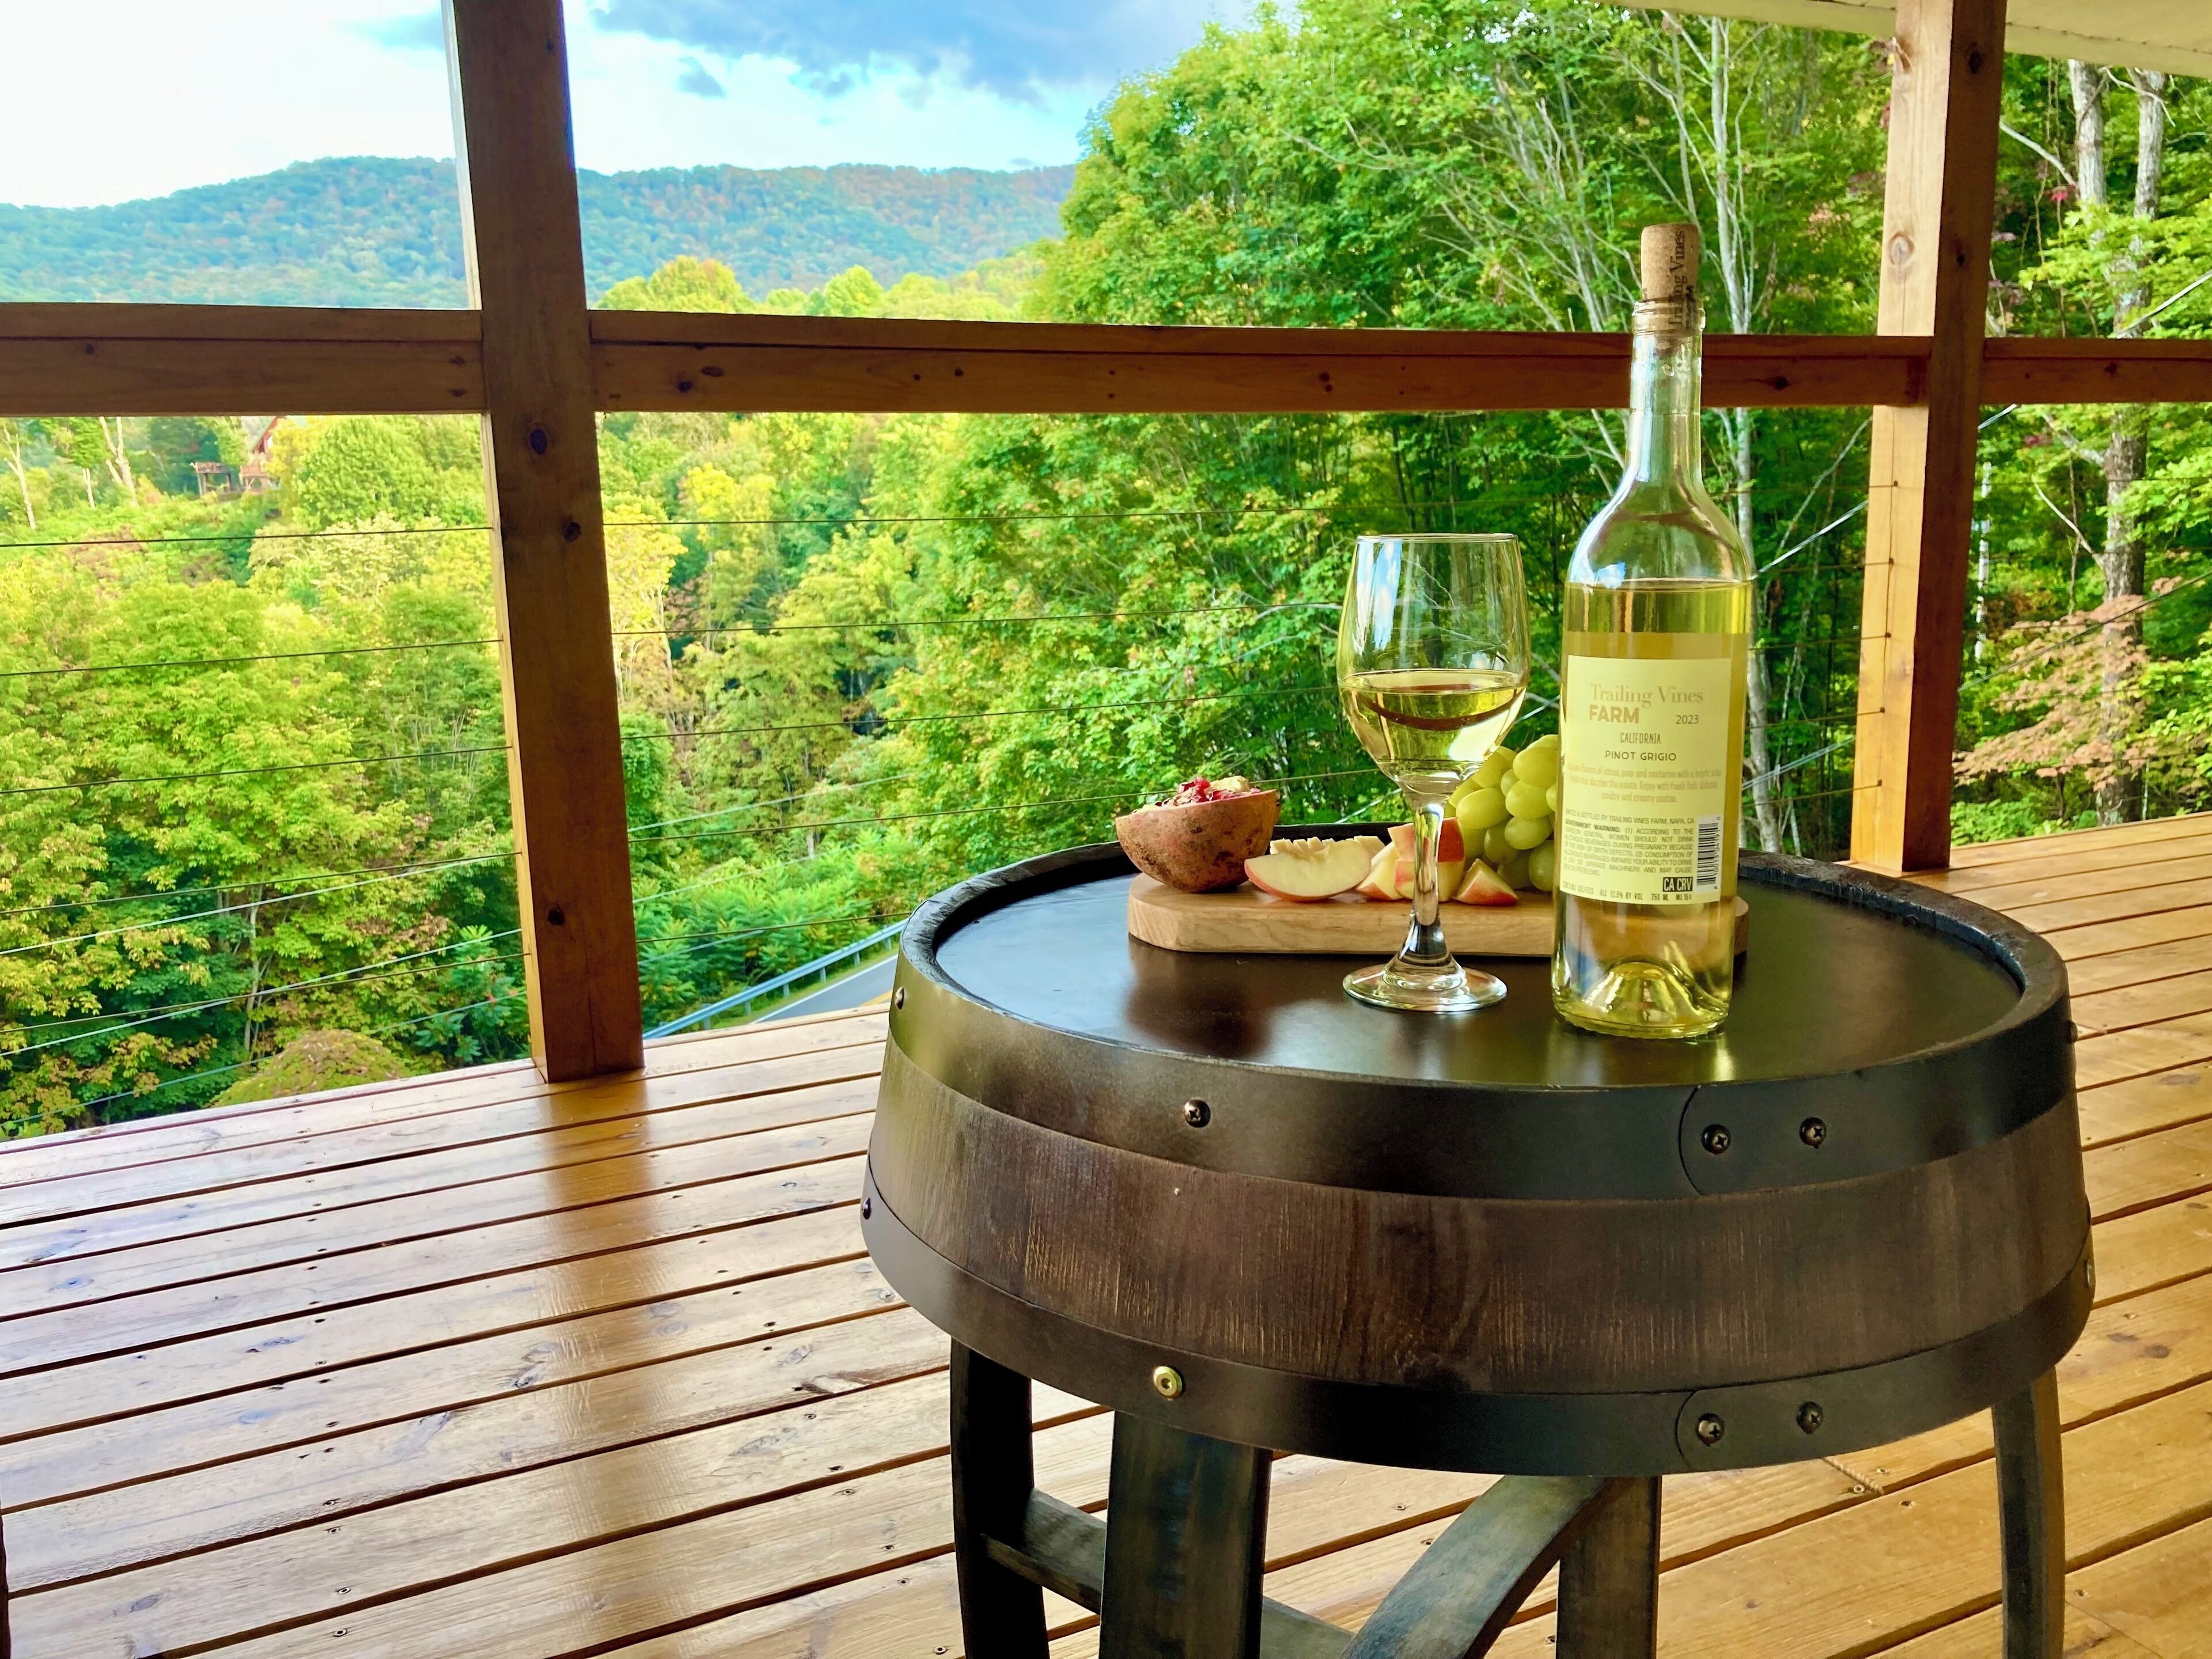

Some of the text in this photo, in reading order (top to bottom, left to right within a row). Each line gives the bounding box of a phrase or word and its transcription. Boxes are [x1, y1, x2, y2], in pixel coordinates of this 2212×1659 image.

[1670, 231, 1685, 273] Vines
[1590, 683, 1704, 709] Trailing Vines
[1589, 704, 1639, 724] FARM
[1676, 715, 1699, 724] 2023
[1620, 732, 1661, 744] CALIFORNIA
[1605, 750, 1677, 761] PINOT GRIGIO
[1609, 815, 1632, 823] TRAILING
[1609, 849, 1634, 857] DEFECTS.
[1609, 864, 1641, 873] MACHINERY,
[1664, 877, 1692, 892] CA CRV
